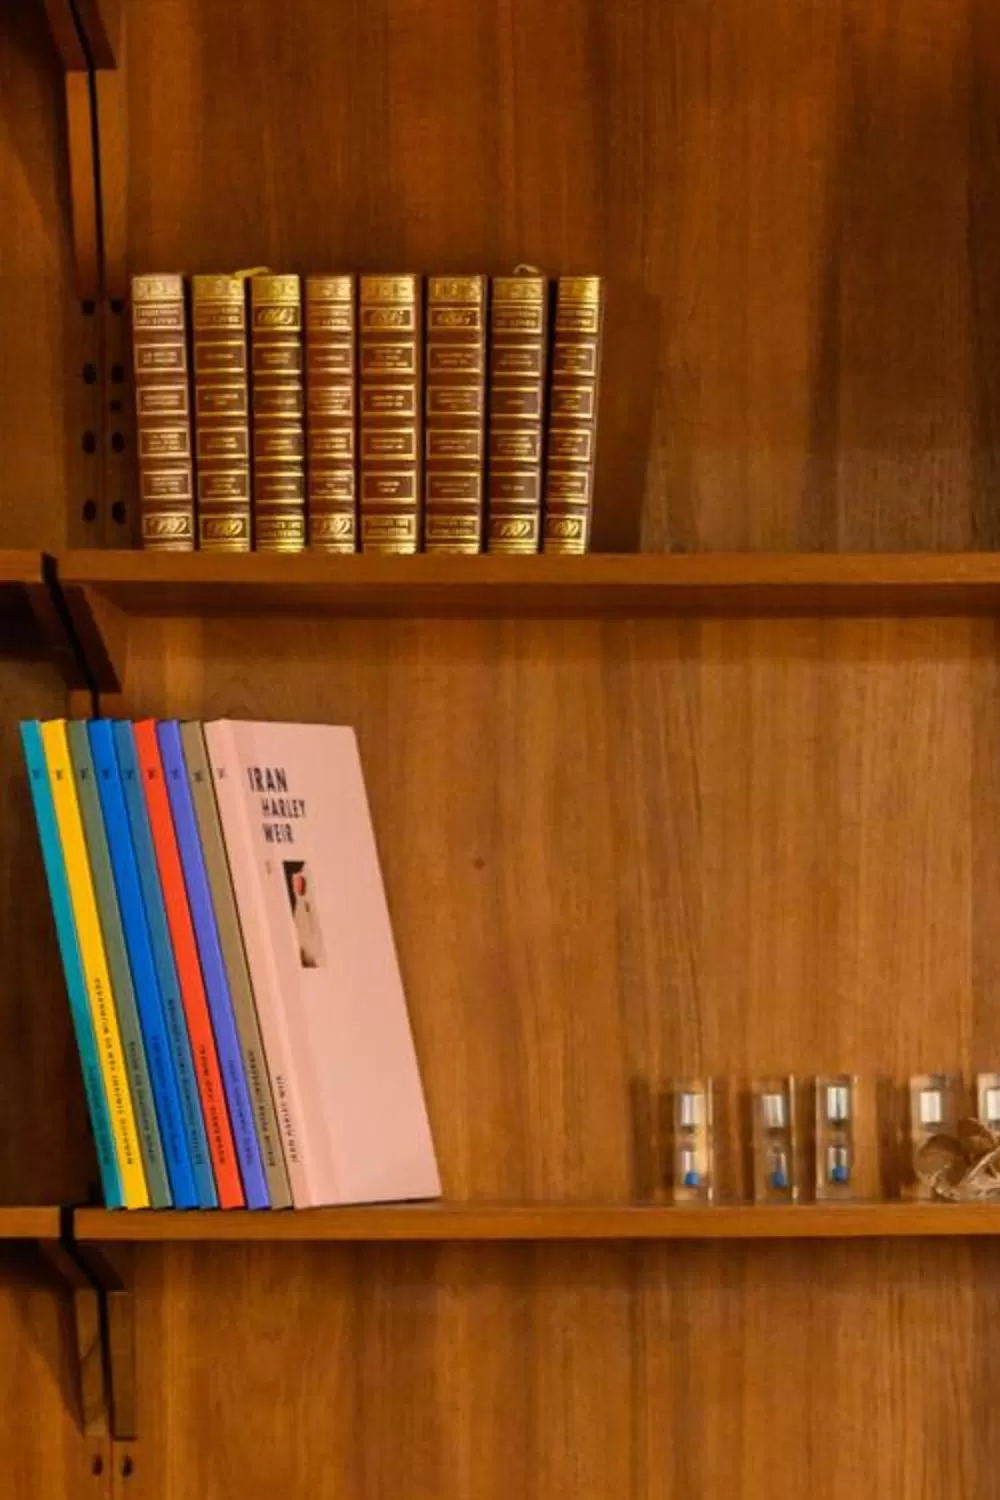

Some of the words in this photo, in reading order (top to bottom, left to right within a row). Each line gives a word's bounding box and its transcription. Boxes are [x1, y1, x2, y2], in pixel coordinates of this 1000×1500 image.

[247, 767, 288, 793] IRAN
[261, 798, 305, 818] HARLEY
[262, 823, 294, 844] WEIR
